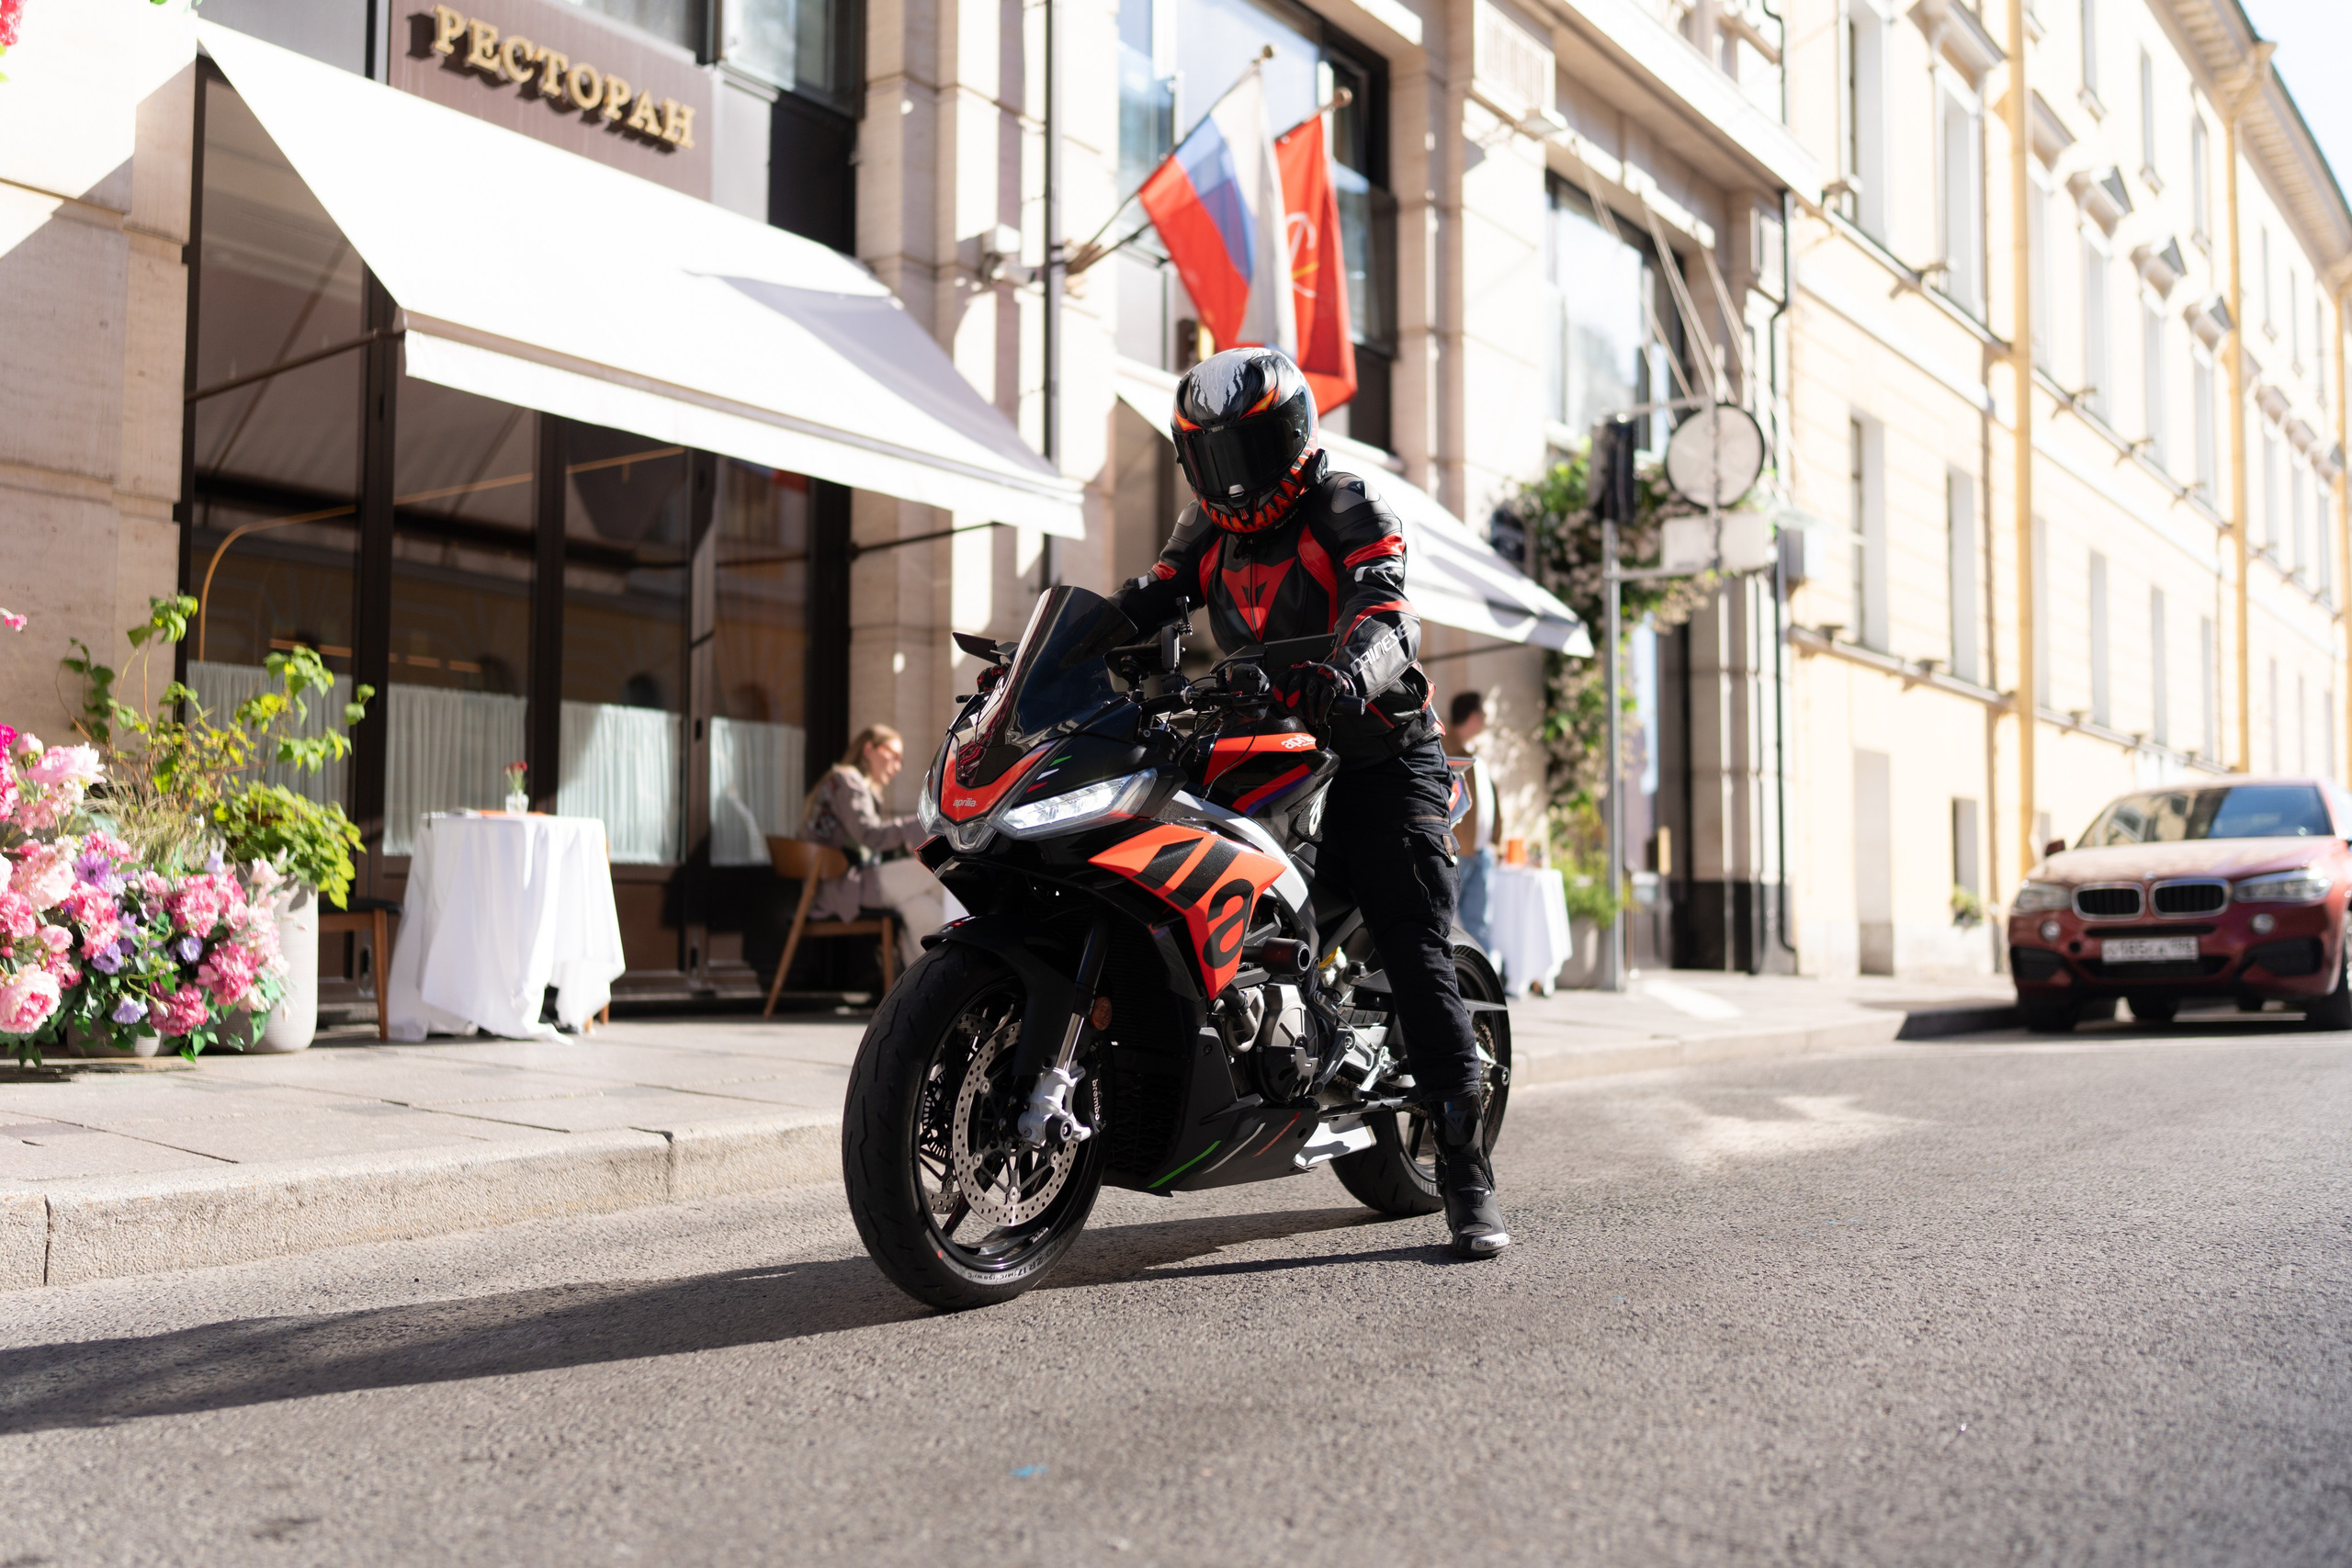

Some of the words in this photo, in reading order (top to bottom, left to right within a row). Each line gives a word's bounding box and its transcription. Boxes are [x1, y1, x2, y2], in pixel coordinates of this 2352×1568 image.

[433, 4, 696, 149] РЕСТОРАН
[1350, 620, 1409, 677] DAINESE
[953, 797, 977, 808] aprilia
[1091, 1078, 1101, 1121] brembo
